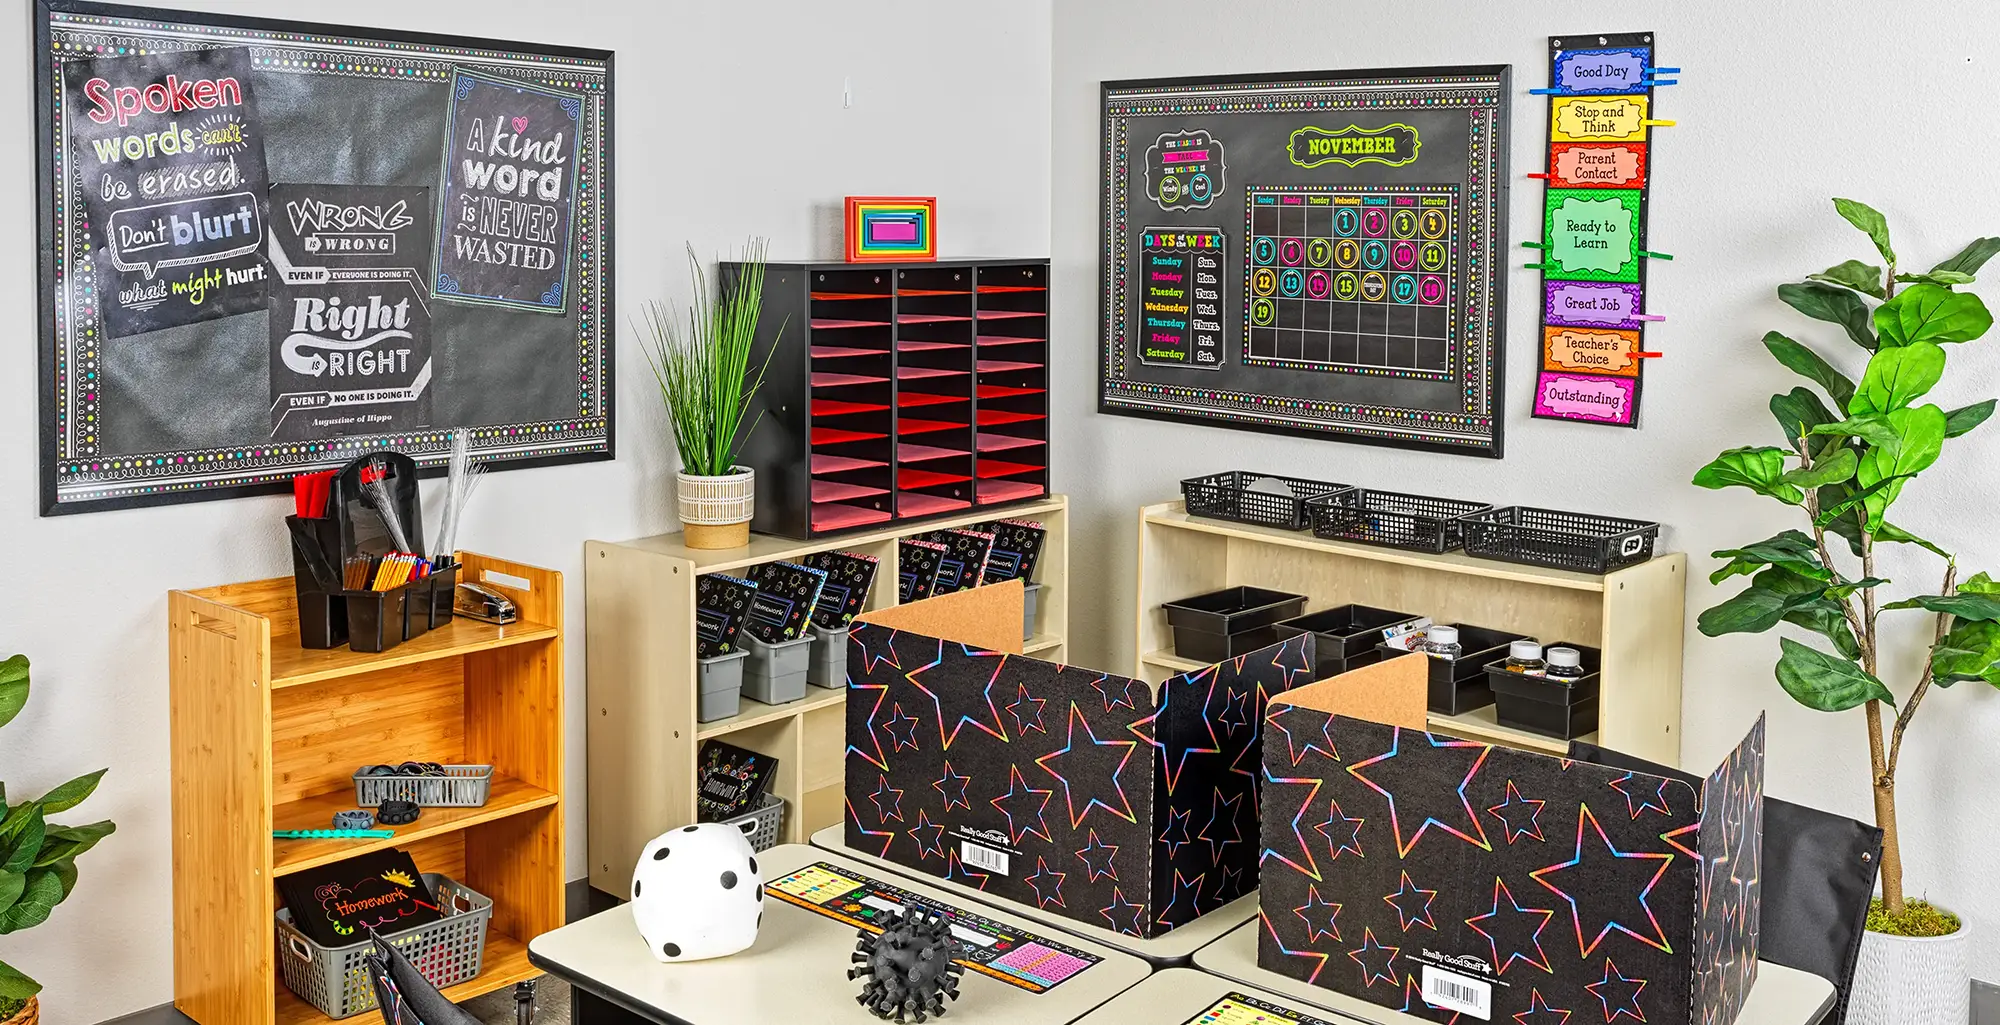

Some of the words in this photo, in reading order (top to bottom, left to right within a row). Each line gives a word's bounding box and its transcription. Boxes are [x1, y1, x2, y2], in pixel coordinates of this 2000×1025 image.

[1574, 66, 1602, 78] Good
[1606, 65, 1629, 80] Day
[84, 75, 242, 126] Spoken
[1575, 106, 1600, 121] Stop
[1602, 105, 1624, 118] and
[1582, 120, 1616, 133] Think
[92, 122, 195, 164] words
[202, 122, 242, 145] can't
[467, 118, 484, 153] A
[488, 115, 566, 165] kind
[1308, 136, 1396, 156] NOVEMBER
[1578, 152, 1616, 164] Parent
[101, 174, 131, 201] be
[143, 155, 245, 194] erased.
[1575, 167, 1618, 180] Contact
[462, 159, 562, 203] word
[1310, 197, 1330, 206] Tuesday
[1334, 197, 1361, 206] Wednesday
[1364, 197, 1388, 206] Thursday
[1423, 197, 1447, 207] Saturday
[286, 198, 413, 236] WRONG
[462, 201, 475, 222] is
[479, 196, 558, 244] NEVER
[1342, 216, 1349, 229] 1
[1371, 216, 1378, 229] 2
[1401, 218, 1408, 231] 3
[1429, 218, 1436, 231] 4
[120, 217, 166, 248] Don't
[171, 206, 252, 246] blurt
[1566, 220, 1602, 233] Ready
[1605, 221, 1616, 232] to
[309, 240, 316, 249] IS
[324, 238, 389, 251] WRONG
[1145, 234, 1175, 247] DAYS
[1176, 240, 1186, 248] the
[1186, 235, 1220, 248] WEEK
[1574, 237, 1608, 249] Learn
[454, 235, 556, 271] WASTED
[1261, 245, 1267, 257] 5
[1288, 246, 1294, 258] 6
[1316, 247, 1323, 259] 7
[1343, 248, 1351, 260] 8
[1371, 248, 1378, 261] 9
[1397, 248, 1411, 262] 10
[1426, 249, 1439, 263] 11
[1152, 257, 1182, 268] Sunday
[1198, 257, 1216, 268] Sun.
[288, 271, 311, 280] EVEN
[313, 271, 324, 280] IF
[332, 271, 369, 279] EVERYONE
[1152, 272, 1182, 283] Monday
[1197, 273, 1216, 284] Mon.
[119, 279, 167, 304] what
[172, 268, 222, 304] might
[226, 264, 268, 286] hurt.
[1258, 276, 1270, 289] 12
[1286, 277, 1297, 290] 13
[1312, 278, 1325, 291] 14
[1340, 280, 1352, 293] 15
[1398, 282, 1411, 296] 17
[1150, 287, 1184, 299] Tuesday
[1196, 288, 1218, 299] Tues.
[1145, 302, 1189, 315] Wednesday
[1196, 304, 1216, 315] Wed.
[1565, 296, 1596, 310] Great
[1600, 298, 1620, 311] Job
[291, 295, 410, 340] Right
[1257, 306, 1268, 318] 19
[1148, 318, 1186, 330] Thursday
[1193, 320, 1220, 330] Thurs.
[1152, 333, 1180, 344] Friday
[1198, 335, 1215, 346] Fri.
[1564, 336, 1619, 350] Teacher's
[1146, 348, 1185, 360] Saturday
[1197, 351, 1215, 362] Sat.
[1573, 352, 1609, 365] Choice
[311, 360, 320, 371] IS
[329, 349, 411, 376] RIGHT
[290, 397, 314, 406] EVEN
[316, 396, 325, 405] IF
[334, 394, 347, 403] NO
[348, 394, 364, 402] ONE
[366, 393, 374, 401] IS
[376, 391, 401, 400] DOING
[403, 390, 414, 399] IT.
[1549, 388, 1620, 408] Outstanding
[312, 416, 354, 428] Augustine
[356, 415, 365, 424] of
[367, 413, 392, 424] Hippo
[754, 602, 784, 616] Homework
[960, 825, 975, 837] Really
[976, 829, 990, 839] Good
[989, 834, 1003, 843] Stuff
[335, 887, 409, 917] Homework
[1422, 948, 1444, 962] Really
[1444, 954, 1463, 966] Good
[1464, 960, 1483, 971] Stuff
